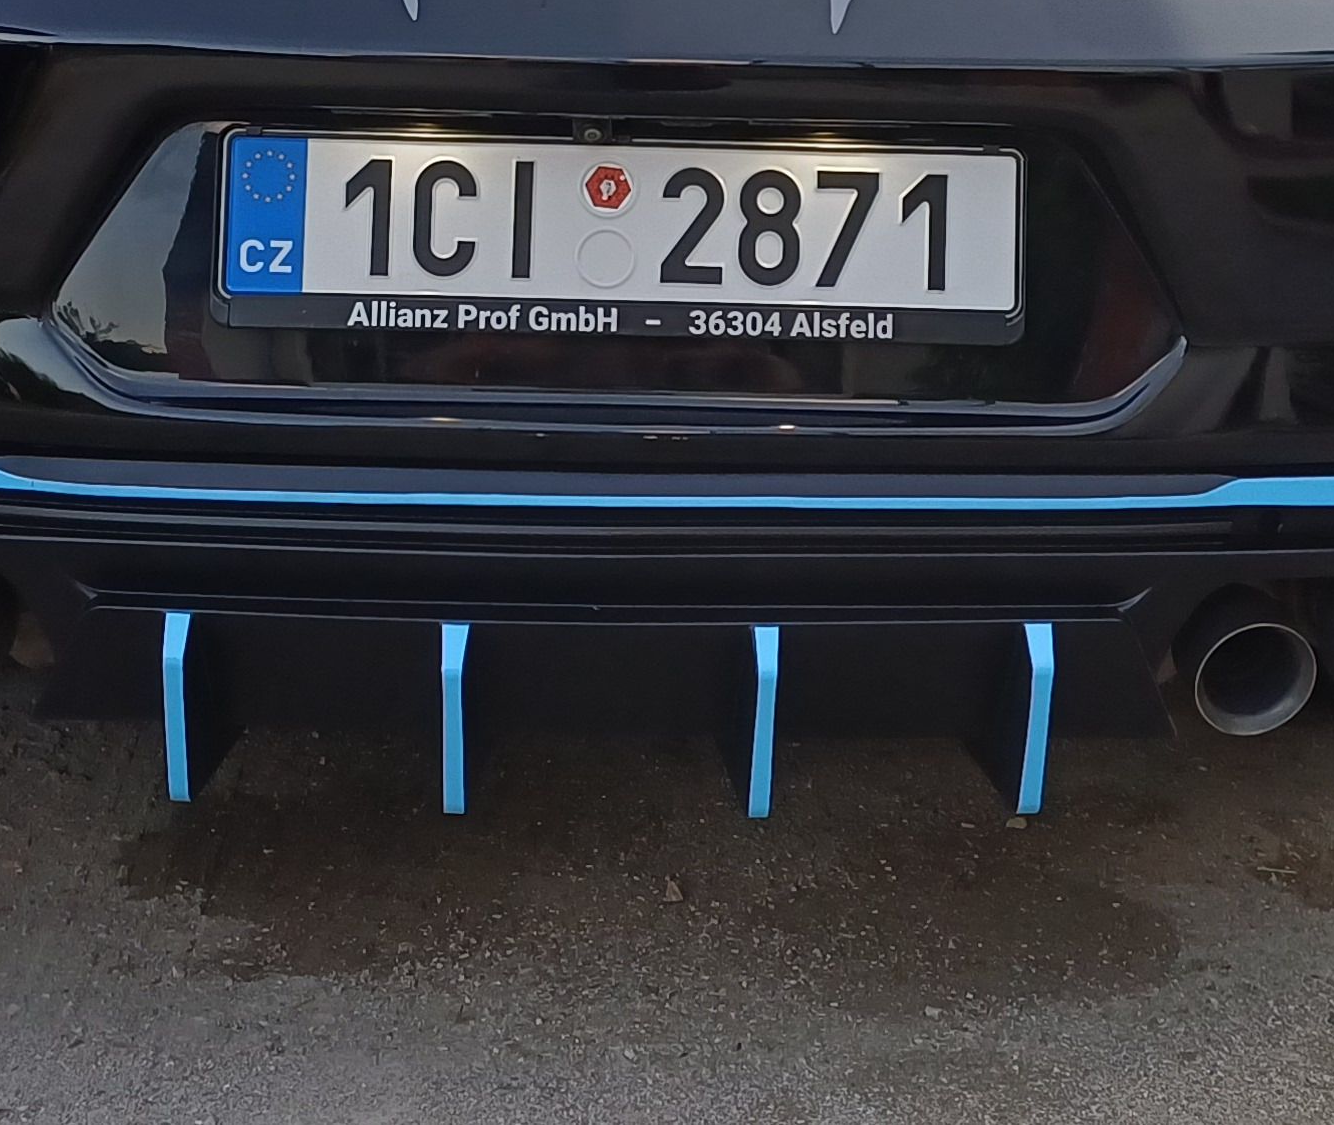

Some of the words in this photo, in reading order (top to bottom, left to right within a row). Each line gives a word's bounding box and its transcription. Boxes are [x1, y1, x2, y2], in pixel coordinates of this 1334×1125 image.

[345, 160, 535, 279] 1CI
[659, 167, 949, 292] 2871
[239, 239, 294, 273] CZ
[346, 300, 449, 329] Allianz
[457, 303, 521, 331] Prof
[528, 305, 618, 333] GmbH
[688, 309, 782, 337] 36304
[789, 311, 893, 339] Alsfeld
